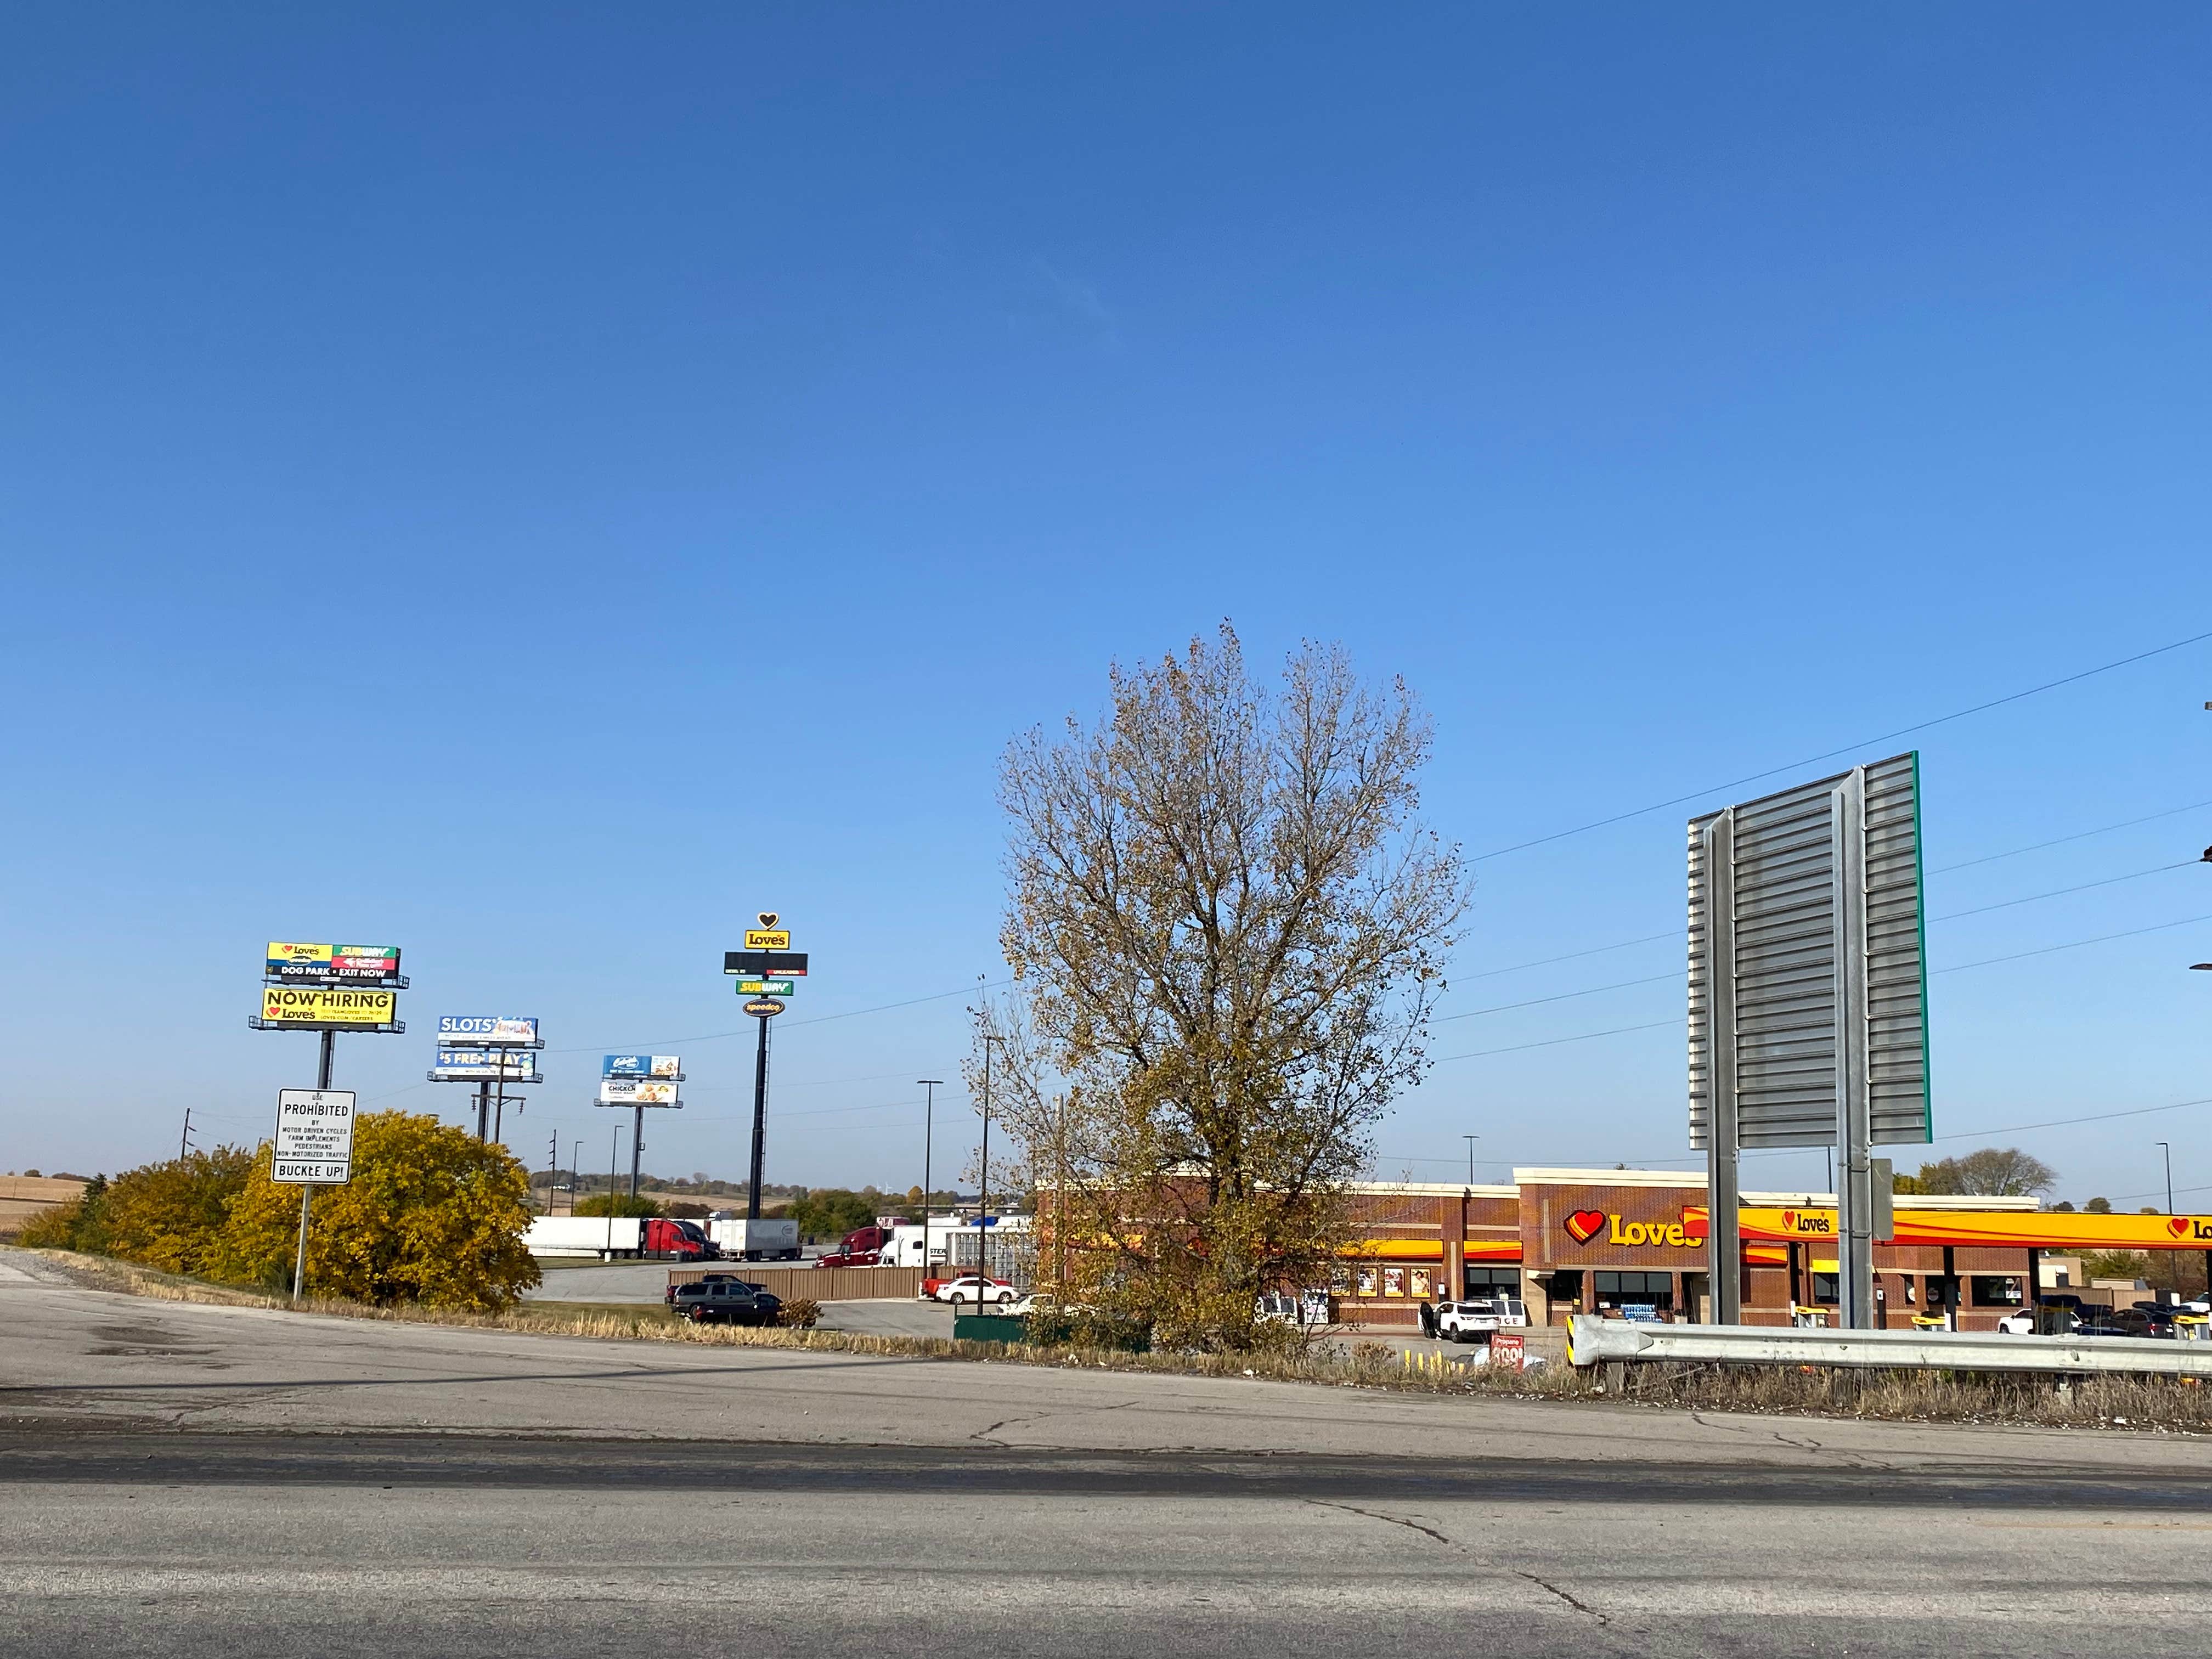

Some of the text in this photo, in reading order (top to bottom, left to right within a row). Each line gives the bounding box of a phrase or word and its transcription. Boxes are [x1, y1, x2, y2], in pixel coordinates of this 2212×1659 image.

[749, 934, 786, 945] Love's
[339, 946, 390, 957] SUBWAY
[281, 966, 386, 977] DOG PARK EXIT NOW
[740, 982, 789, 992] SUBWAY
[268, 992, 388, 1007] NOW HIRING
[281, 1008, 315, 1019] Love's
[441, 1017, 493, 1032] SLOTS
[284, 1104, 348, 1116] PROHIBITED
[279, 1165, 343, 1177] BUCKLE UP!
[1797, 1211, 1830, 1233] Love's
